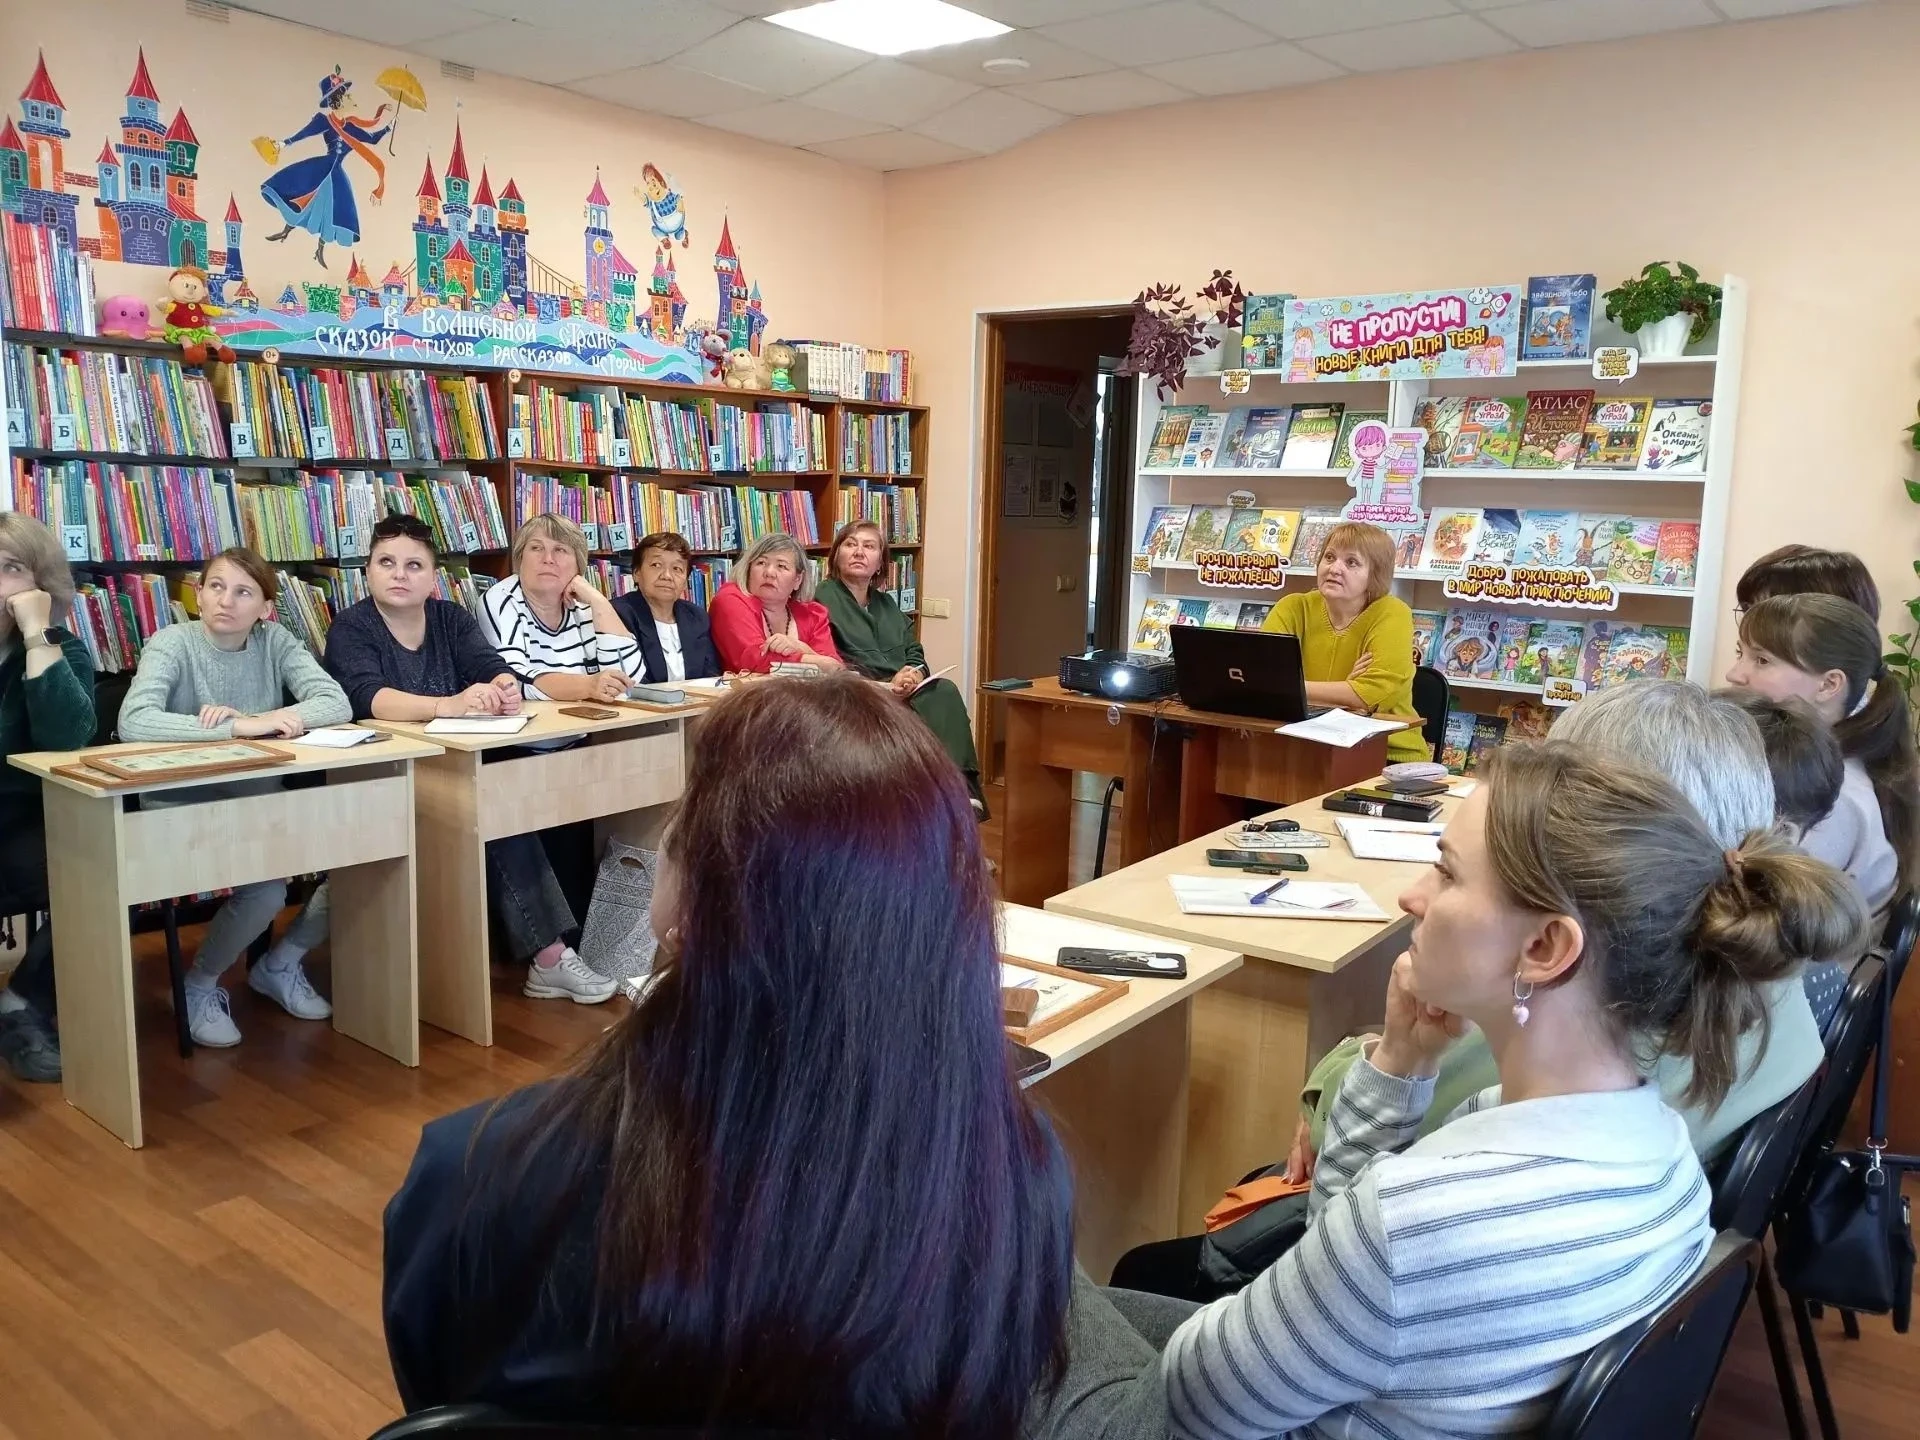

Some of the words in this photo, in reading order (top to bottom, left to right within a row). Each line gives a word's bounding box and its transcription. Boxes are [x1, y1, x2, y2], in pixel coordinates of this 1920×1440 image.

[383, 305, 400, 329] В
[1331, 322, 1354, 344] НЕ
[1358, 299, 1461, 343] ПРОПУСТИ!
[265, 350, 278, 359] 0+
[1314, 351, 1361, 374] НОВЫЕ
[1361, 341, 1409, 366] КНИГИ
[1411, 334, 1446, 357] ДЛЯ
[1448, 325, 1489, 350] ТЕБЯ!
[1484, 403, 1503, 412] СТОП
[1530, 396, 1587, 410] АТЛАС
[1606, 404, 1627, 413] СТОП
[8, 420, 19, 432] А
[58, 426, 70, 438] Б
[238, 434, 248, 445] В
[1662, 430, 1700, 440] Океаны
[317, 436, 326, 448] Г
[390, 437, 402, 450] Д
[512, 438, 522, 448] А
[618, 447, 626, 456] Б
[713, 453, 720, 462] В
[344, 534, 354, 546] Л
[464, 532, 476, 543] Н
[614, 530, 624, 540] К
[722, 532, 730, 542] Л
[68, 535, 82, 548] К
[1196, 552, 1235, 569] ПРОЧТИ
[1236, 552, 1279, 570] ПЕРВЫМ
[1200, 570, 1215, 582] НЕ
[1216, 570, 1283, 585] ПОЖАЛЕЕШЬ!
[1467, 566, 1504, 580] ДОБРО
[1511, 568, 1588, 585] ПОЖАЛОВАТЬ
[1448, 581, 1457, 592] В
[1459, 582, 1482, 596] МИР
[1484, 582, 1522, 598] НОВЫХ
[1525, 586, 1613, 604] ПРИКЛЮЧЕНИЙ!
